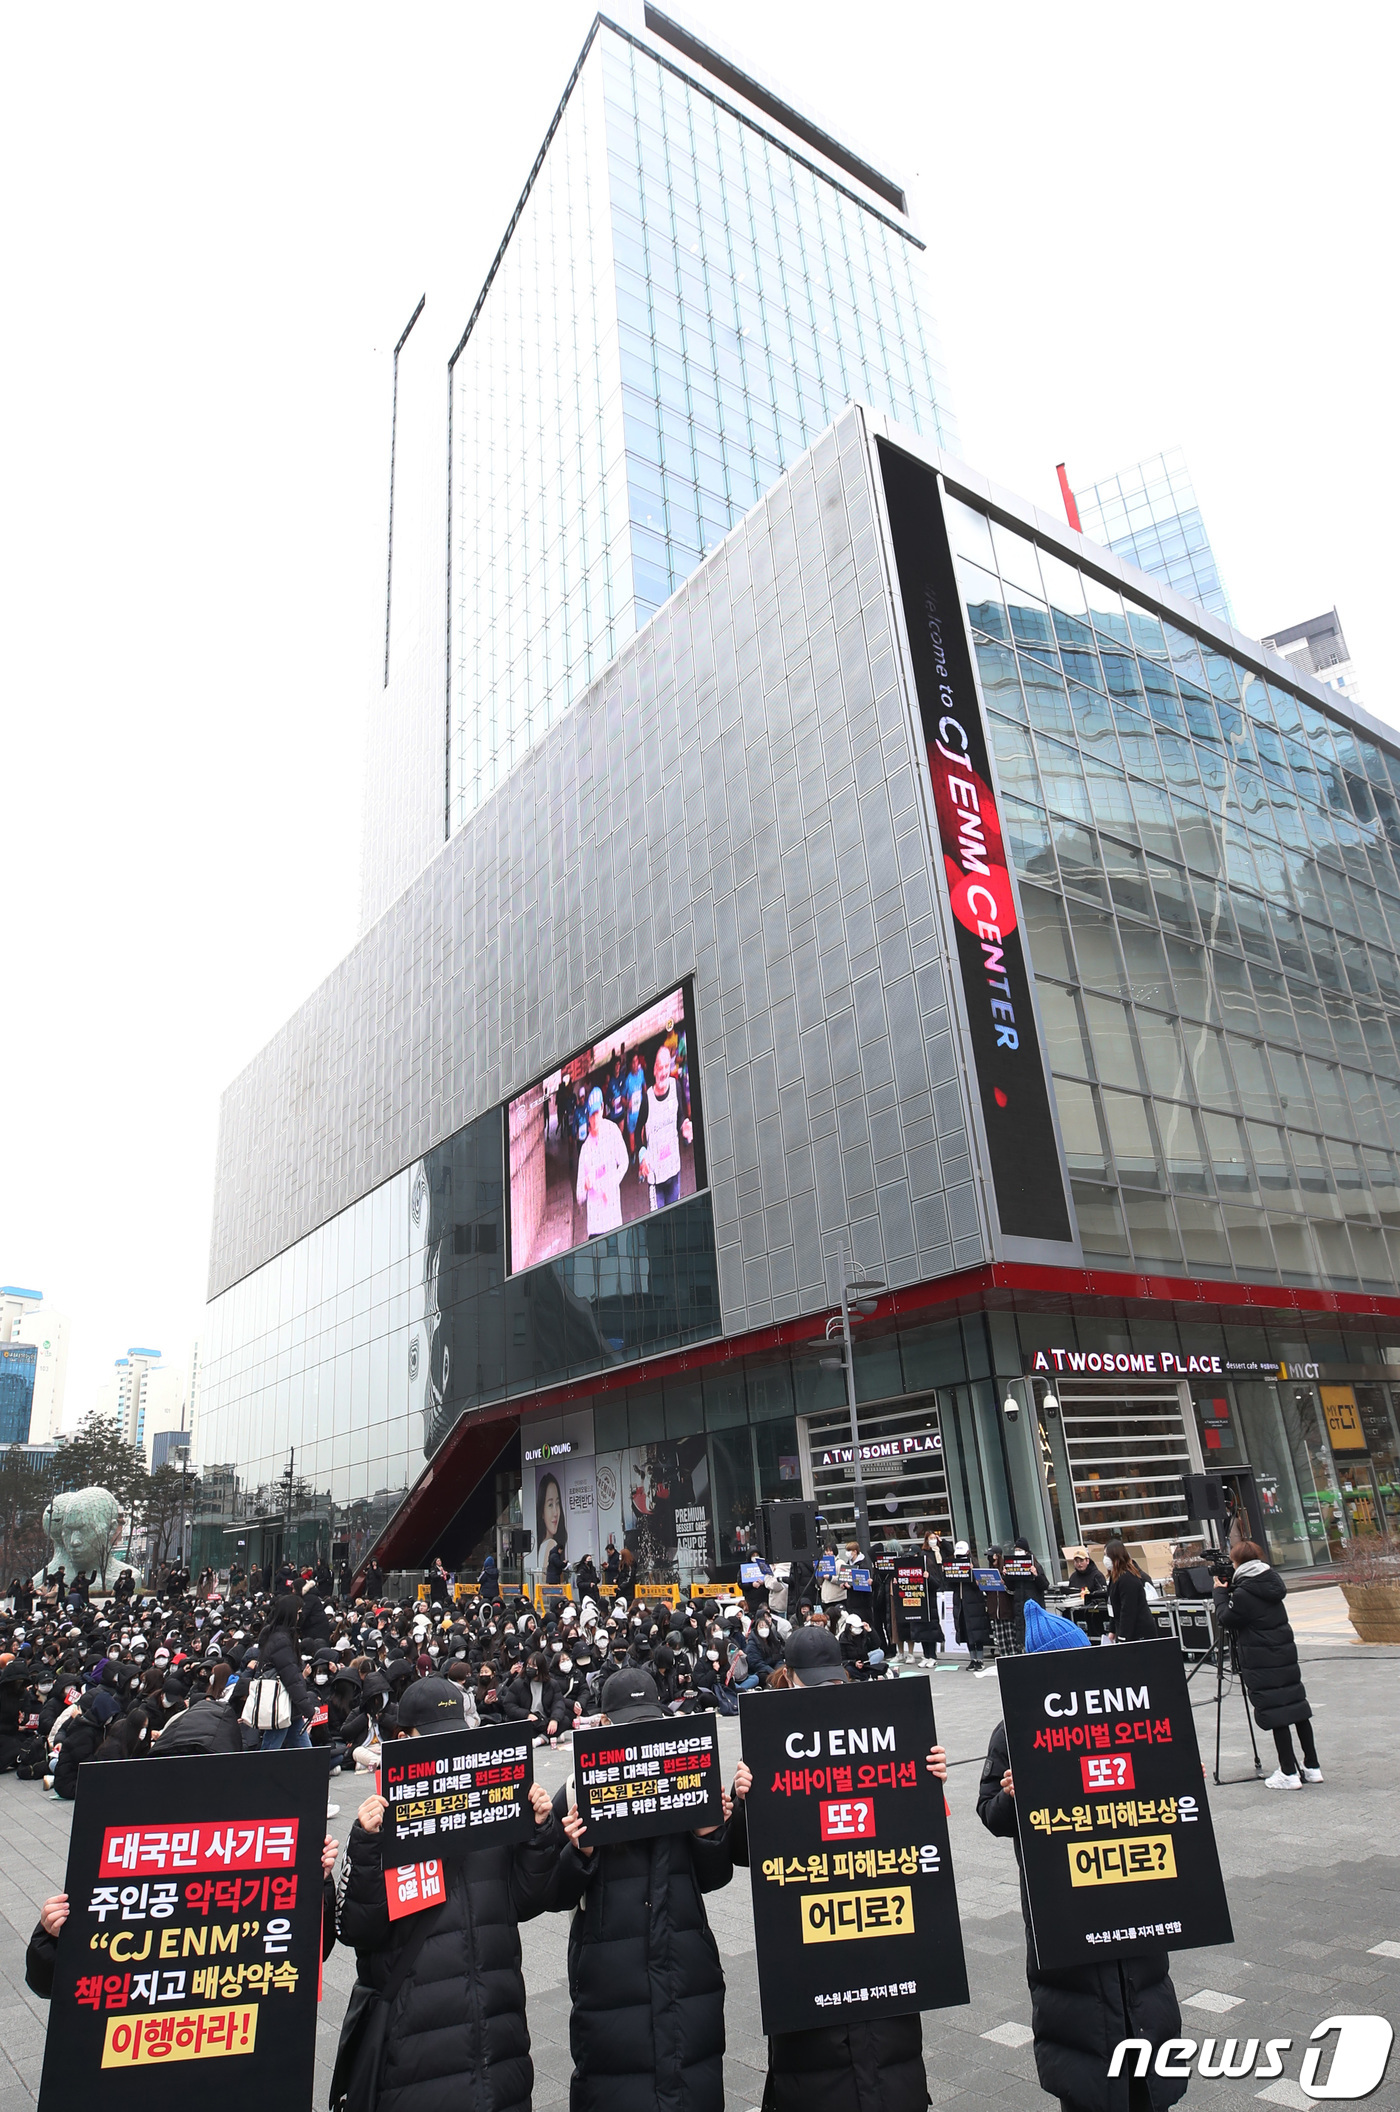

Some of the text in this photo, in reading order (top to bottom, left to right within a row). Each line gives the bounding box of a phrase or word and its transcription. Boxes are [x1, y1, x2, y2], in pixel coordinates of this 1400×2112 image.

[939, 685, 955, 708] to
[935, 715, 973, 772] CJ
[948, 774, 990, 877] ENM
[966, 883, 1020, 1051] CENTER
[1035, 1348, 1222, 1374] A TWOSOME PLACE
[525, 1442, 571, 1460] OLIVE YOUNG
[823, 1453, 831, 1465] A
[570, 1493, 594, 1510] 탄력받다
[675, 1506, 705, 1523] PREMIUM
[676, 1522, 694, 1533] DESSERT
[682, 1536, 697, 1549] CUP
[698, 1536, 706, 1548] OF
[1044, 1685, 1150, 1718] CJ ENM
[580, 1735, 713, 1768] CJ ENM이 피해보상으로
[785, 1726, 896, 1759] CJ ENM
[1033, 1718, 1173, 1753] 서바이벌 오디션
[388, 1745, 528, 1783] CJ ENM이 피해보상으로
[582, 1753, 711, 1785] 내놓은 대책은 펀드조성
[771, 1761, 918, 1797] 서바이벌 오디션
[1087, 1757, 1127, 1788] 또?
[389, 1763, 525, 1802] 내놓은 대책은 펀드조성
[590, 1784, 627, 1804] 엑스원
[396, 1802, 521, 1840] 누구를 위한 보상인가
[397, 1799, 436, 1821] 엑스원
[590, 1789, 709, 1821] 누구를 위한 보상인가
[826, 1802, 869, 1835] 또?
[1029, 1795, 1200, 1835] 엑스원 피해보상은
[107, 1825, 295, 1870] 대국민 사기극
[1075, 1842, 1168, 1880] 어디로?
[762, 1844, 941, 1886] 엑스원 피해보상은
[88, 1882, 179, 1922] 주인공
[184, 1874, 298, 1915] 악덕기업
[809, 1894, 905, 1936] 어디로?
[1085, 1921, 1182, 1945] 엑스원 새그룹 지지 팬 연합
[74, 1960, 299, 2011] 책임지고 배상약속
[814, 1981, 917, 2007] 엑스원 새그룹 지지 팬 연합
[111, 2012, 250, 2060] 이행하라!
